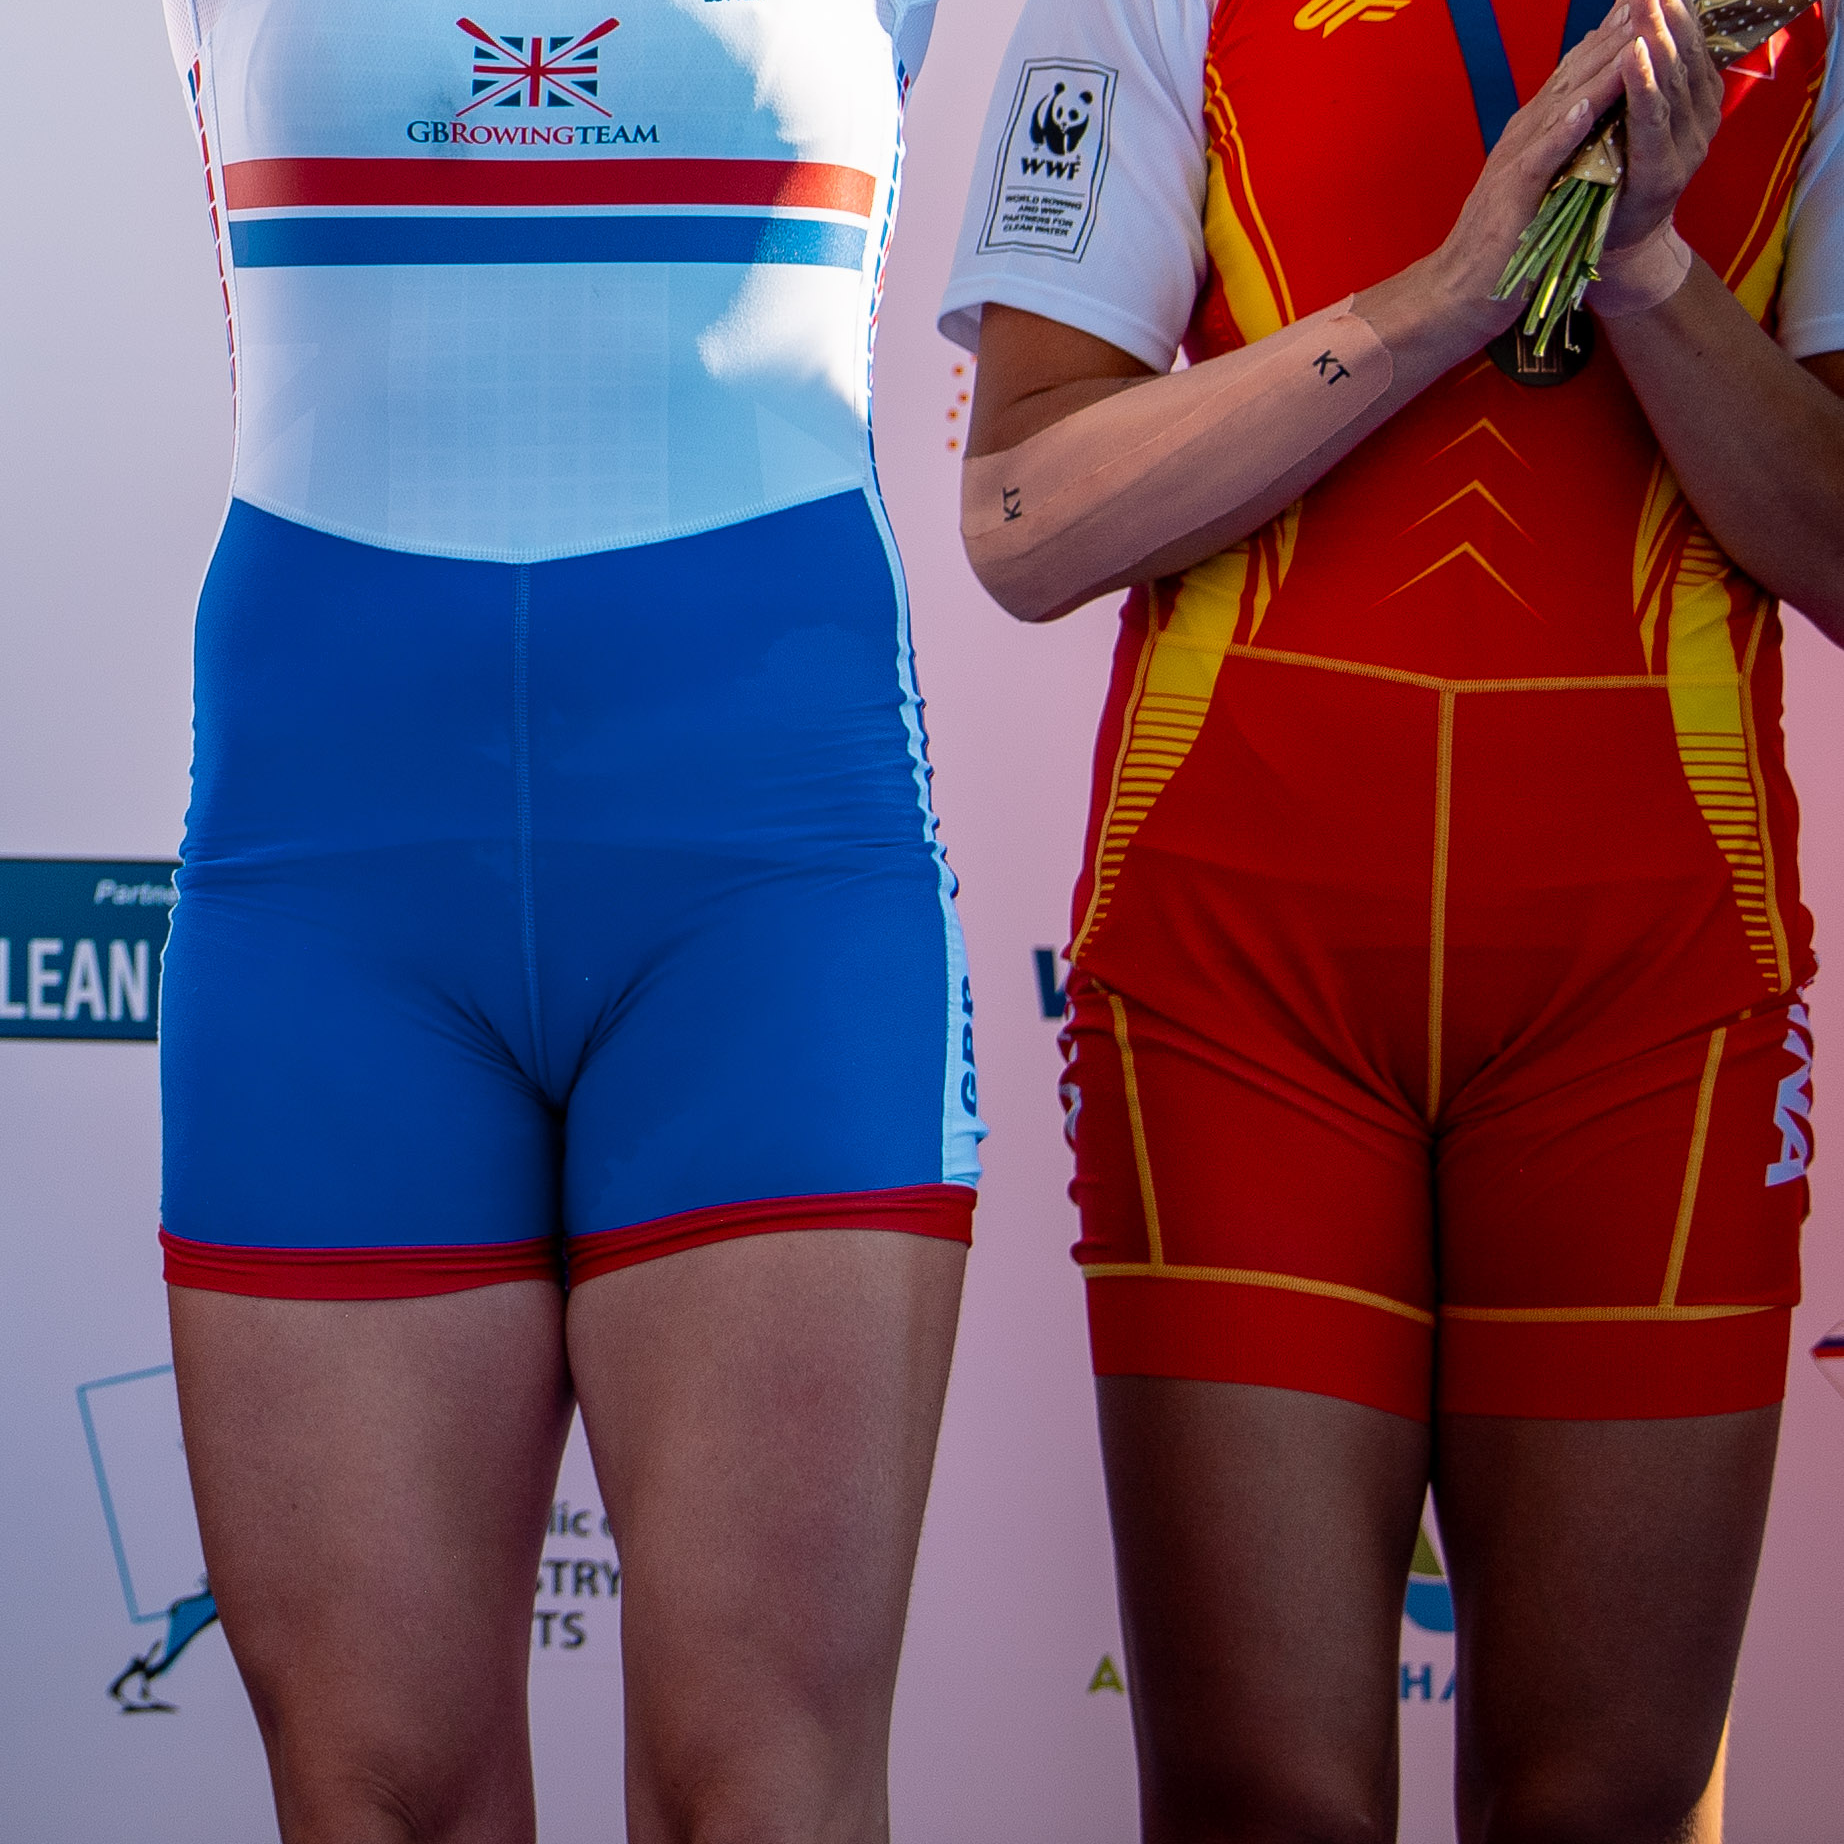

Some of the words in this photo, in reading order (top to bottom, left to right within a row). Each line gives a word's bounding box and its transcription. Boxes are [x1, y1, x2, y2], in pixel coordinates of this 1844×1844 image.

[1021, 157, 1081, 181] WWF
[1312, 349, 1350, 386] KT
[1002, 486, 1023, 523] KT
